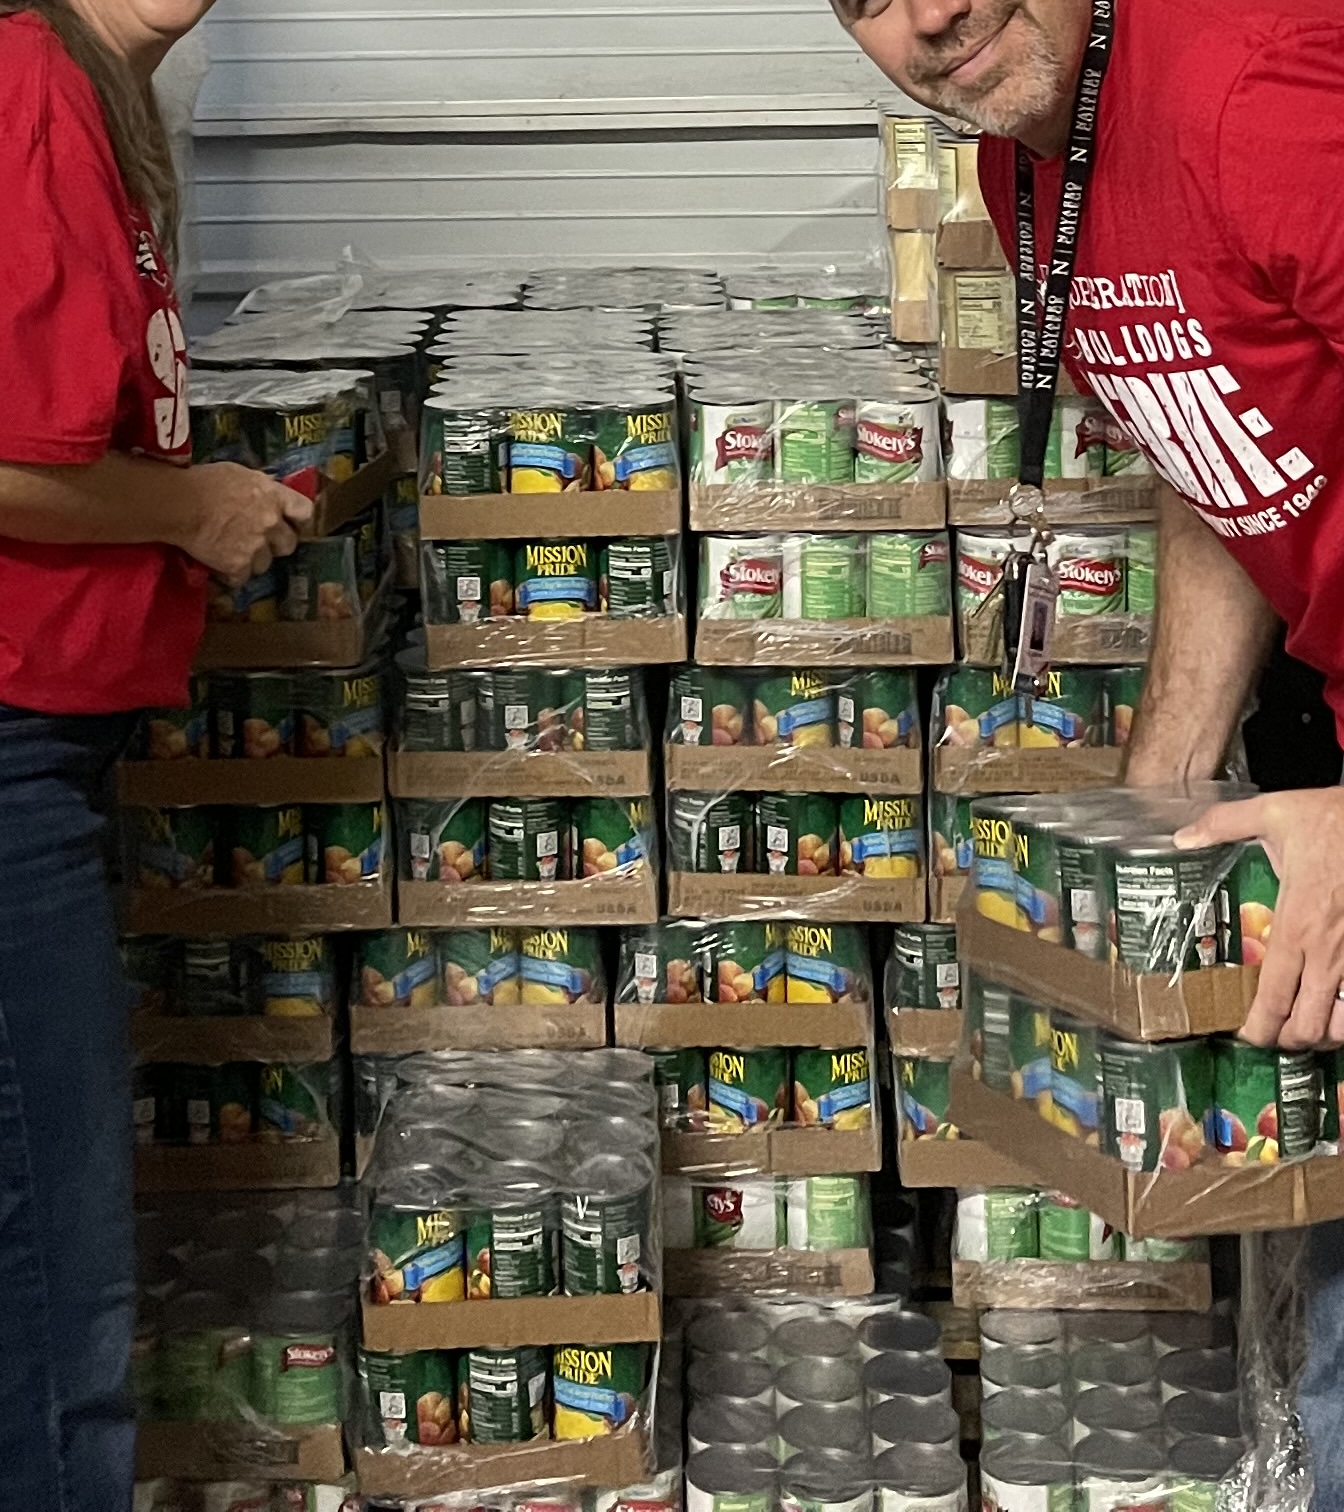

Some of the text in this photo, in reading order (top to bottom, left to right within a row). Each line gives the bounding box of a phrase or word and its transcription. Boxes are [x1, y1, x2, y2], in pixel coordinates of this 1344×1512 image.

[1089, 32, 1107, 51] N
[1069, 145, 1088, 164] N
[1051, 258, 1070, 277] N
[1075, 318, 1213, 365] BULLDOGS
[1036, 371, 1053, 389] N
[1241, 504, 1288, 538] SINCE
[525, 543, 588, 570] MISSION
[536, 562, 579, 577] PRIDE
[859, 771, 901, 786] USDA
[862, 899, 903, 913] USDA
